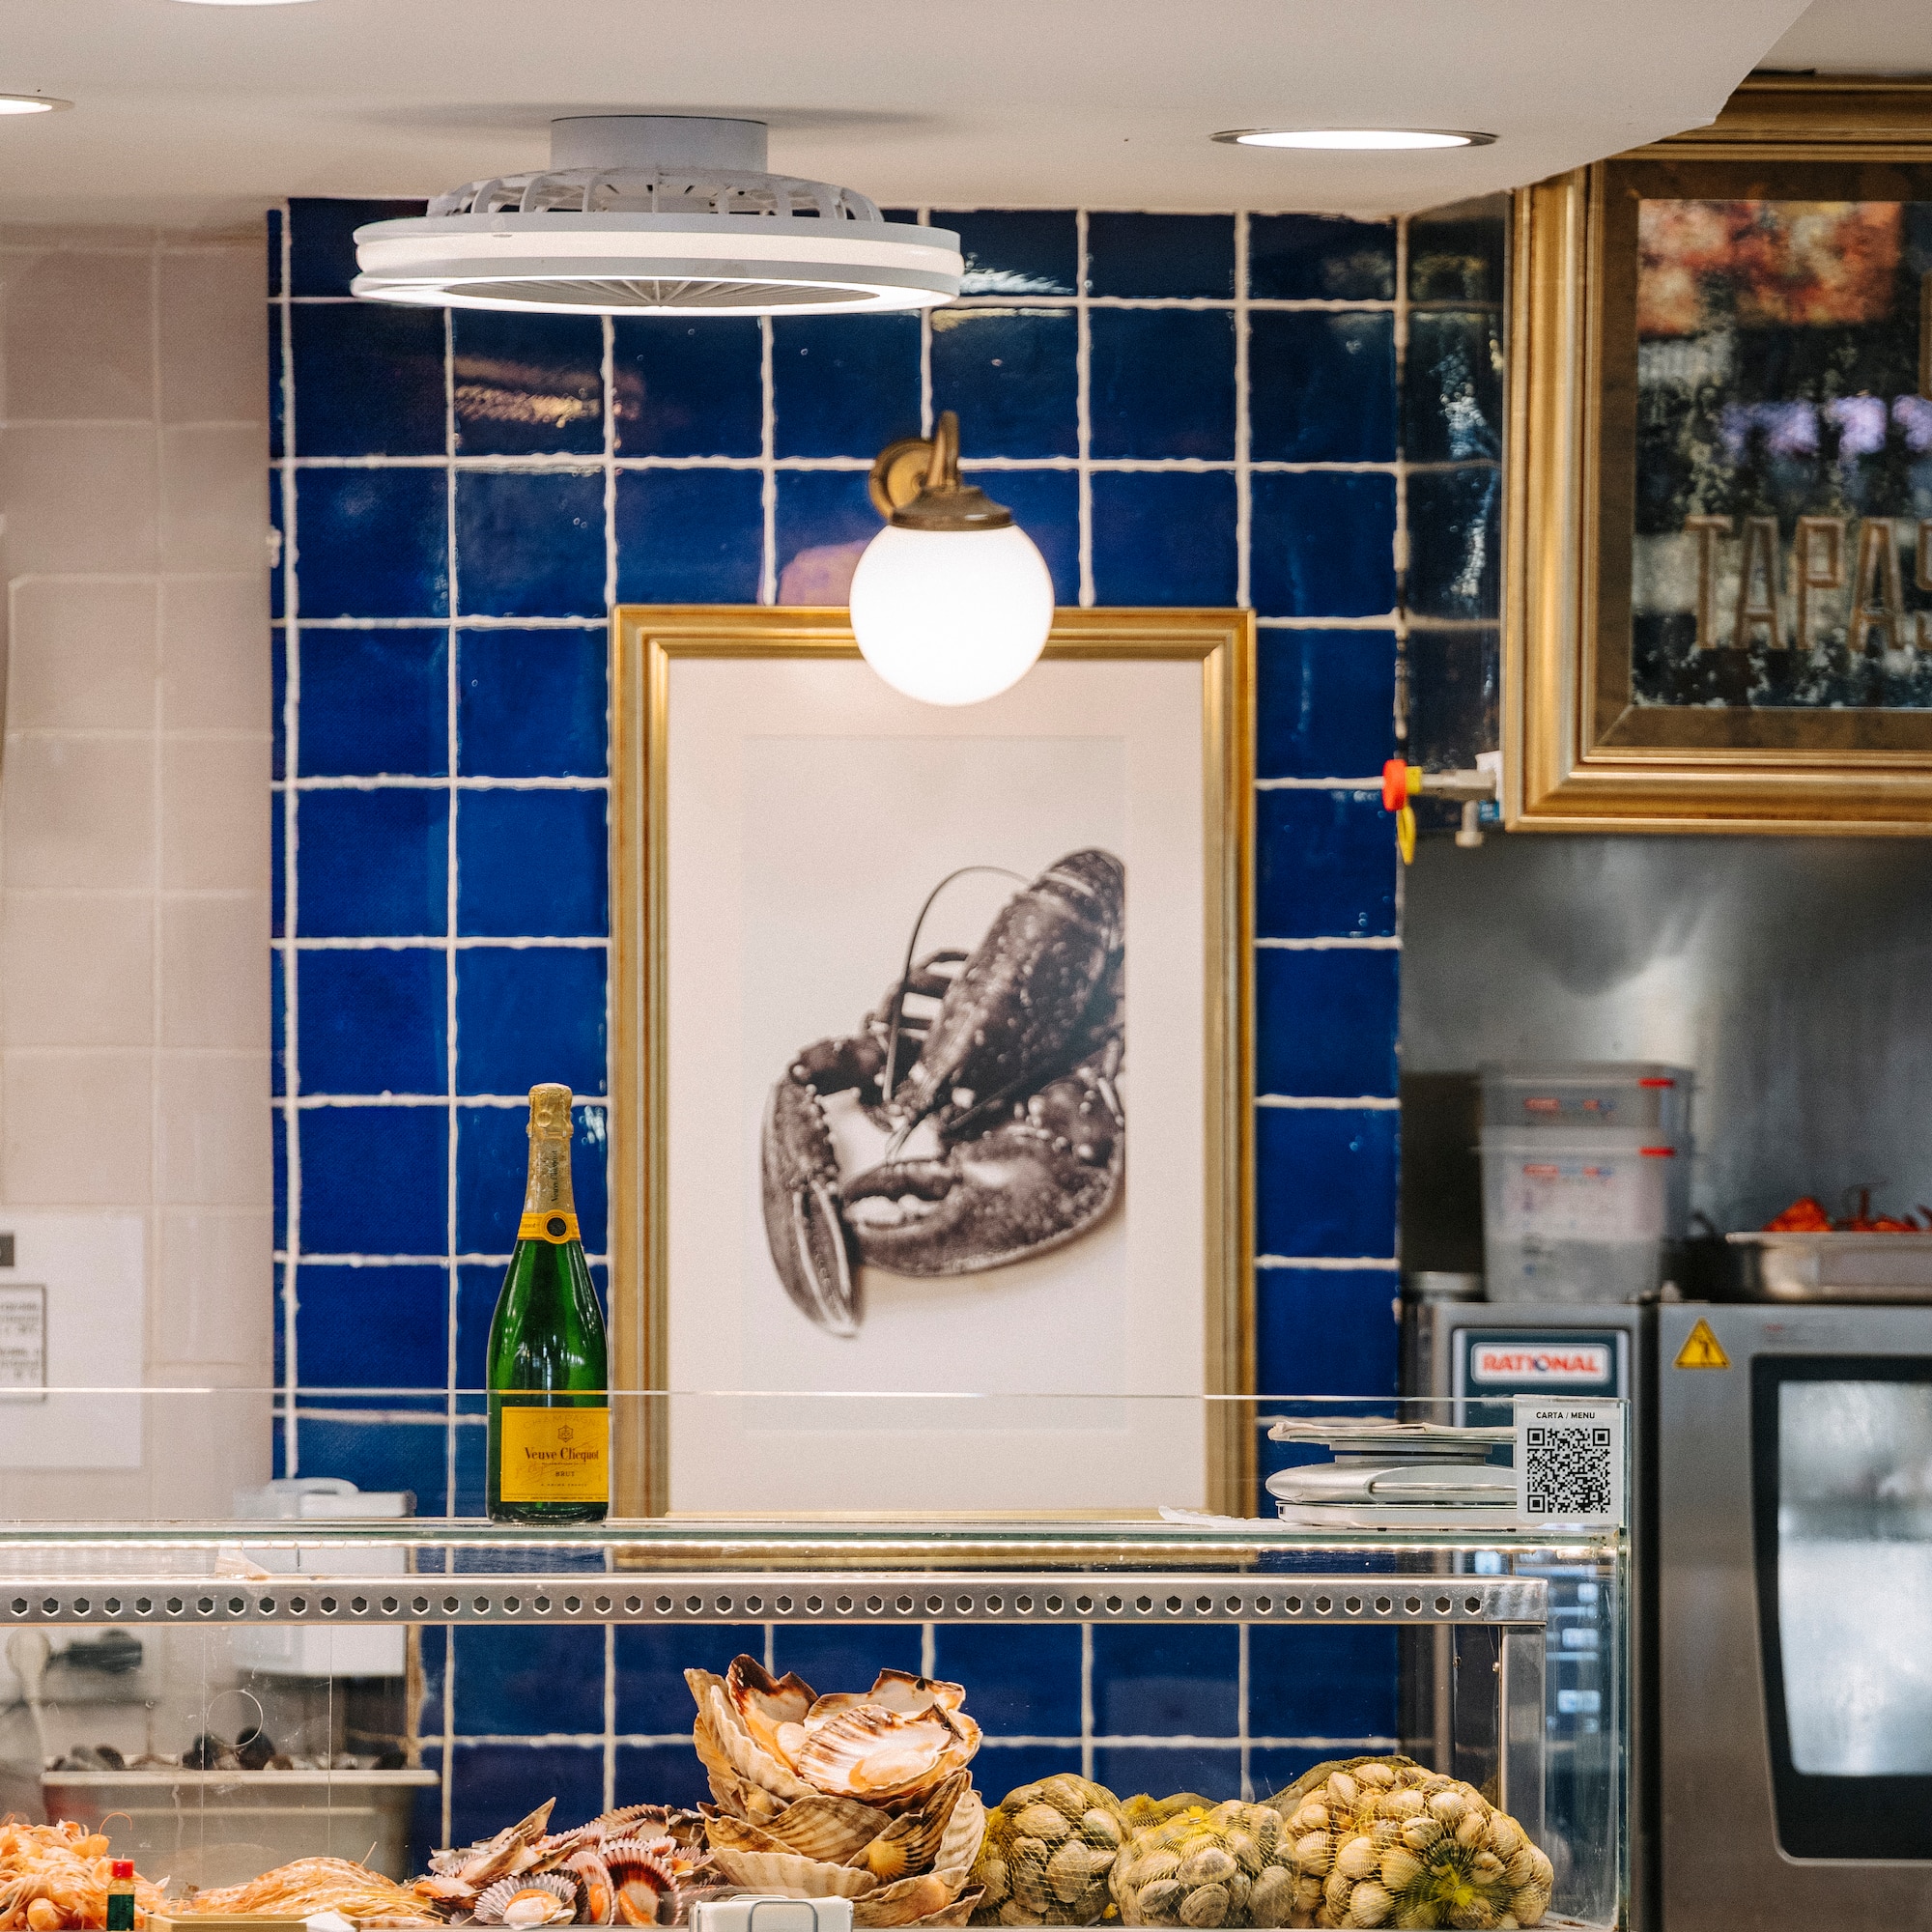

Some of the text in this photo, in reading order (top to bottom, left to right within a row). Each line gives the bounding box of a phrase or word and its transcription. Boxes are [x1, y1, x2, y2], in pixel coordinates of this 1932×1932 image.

[1483, 1354, 1598, 1372] RATIONAL
[525, 1447, 599, 1463] Veuve Clicquot
